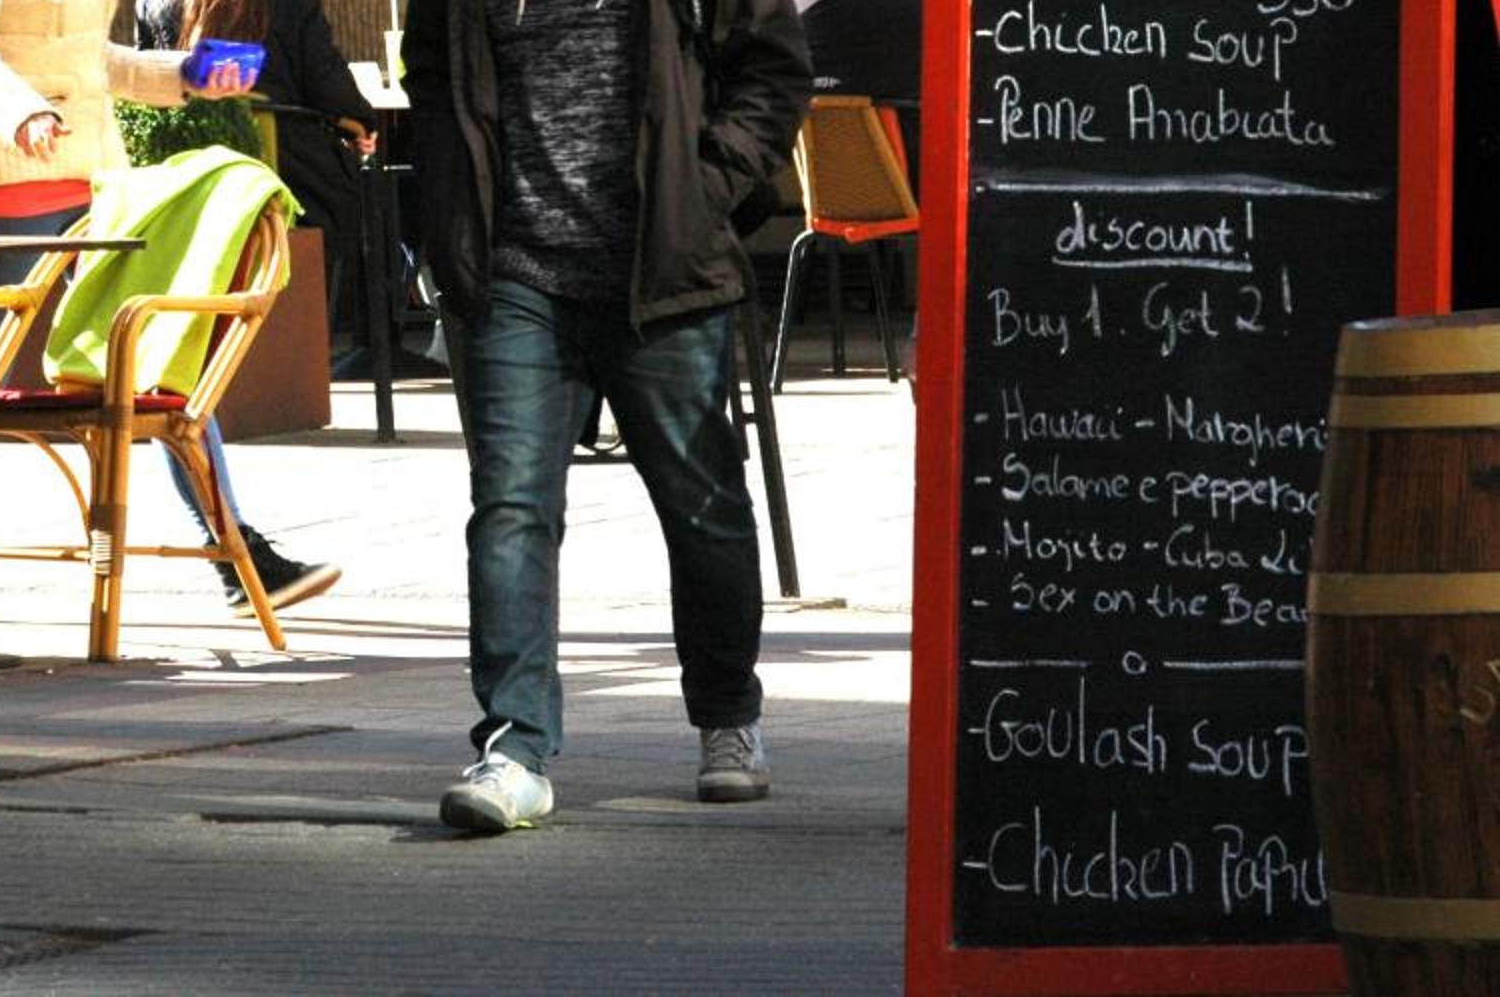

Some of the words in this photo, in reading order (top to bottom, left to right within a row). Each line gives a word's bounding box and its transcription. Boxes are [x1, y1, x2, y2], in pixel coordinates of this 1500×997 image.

[987, 288, 1069, 355] Buy
[1142, 282, 1219, 357] Get
[1165, 394, 1330, 467] Margheri
[1011, 573, 1076, 613] Sex
[1093, 588, 1135, 614] on
[1147, 584, 1208, 618] the
